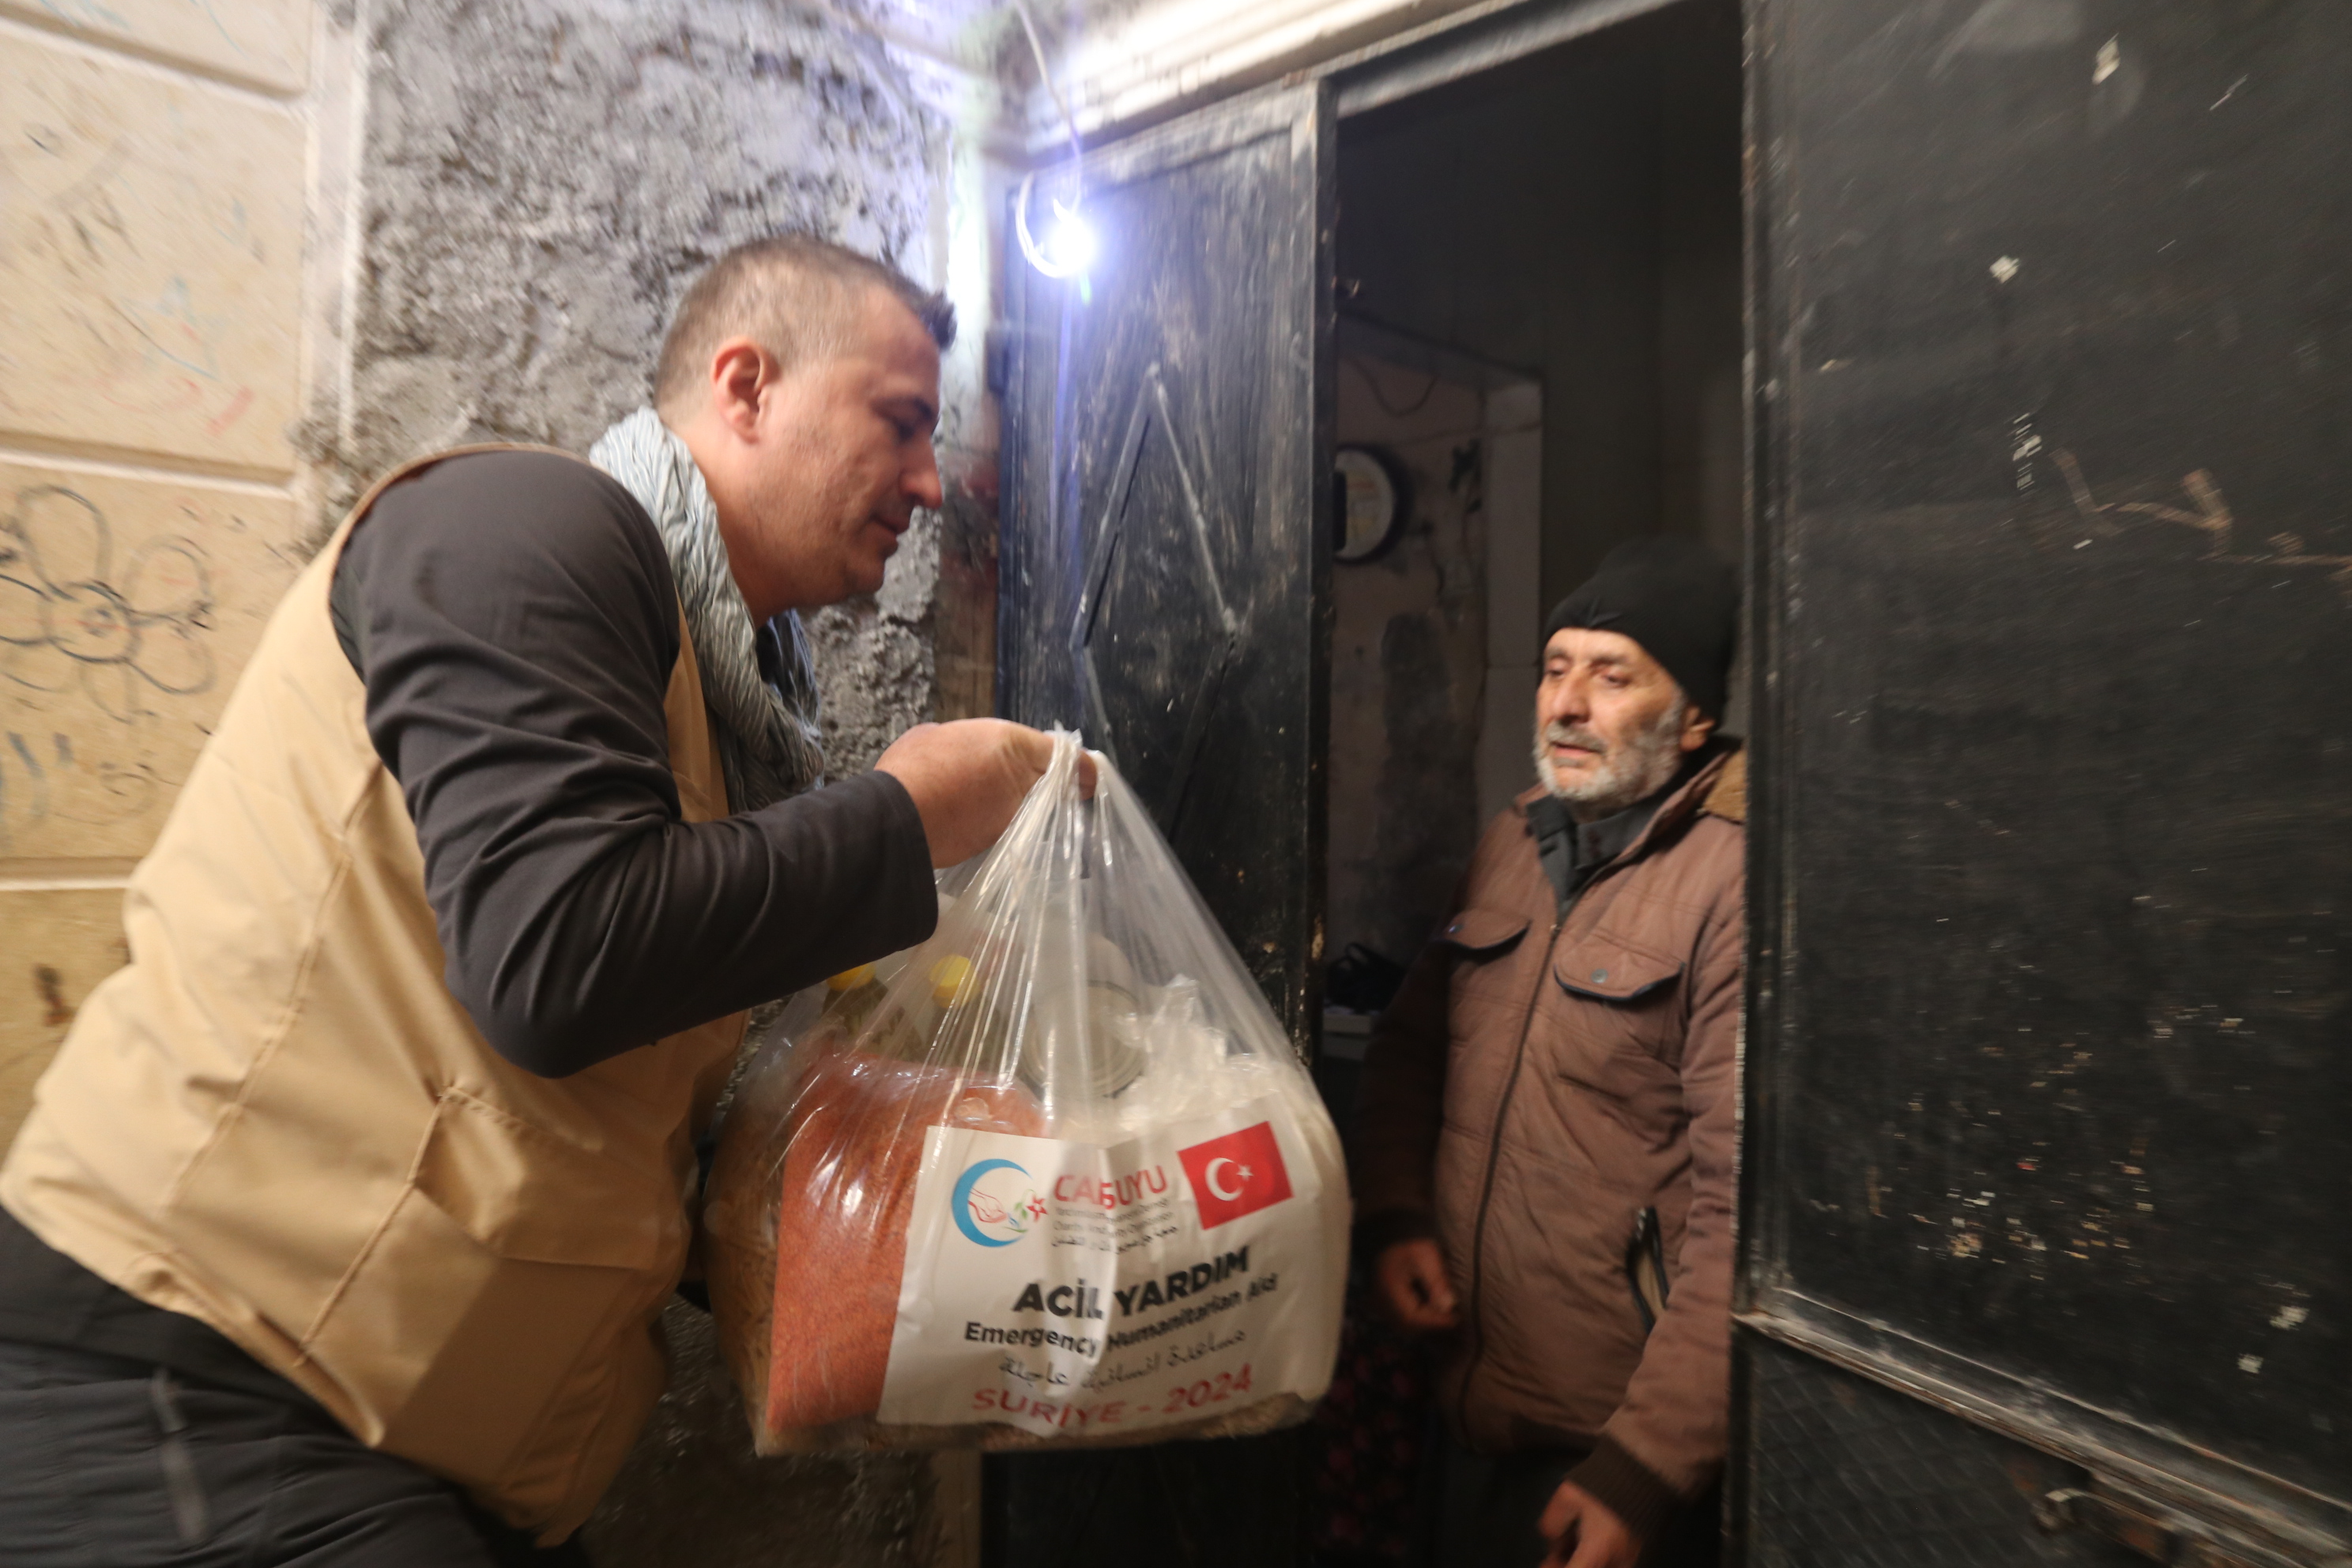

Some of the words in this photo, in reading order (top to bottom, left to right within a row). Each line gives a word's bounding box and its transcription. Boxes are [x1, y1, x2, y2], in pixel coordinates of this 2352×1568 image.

[1012, 1278, 1104, 1320] ACİL
[1114, 1245, 1250, 1317] YARDIM
[1162, 1363, 1253, 1414] 2024
